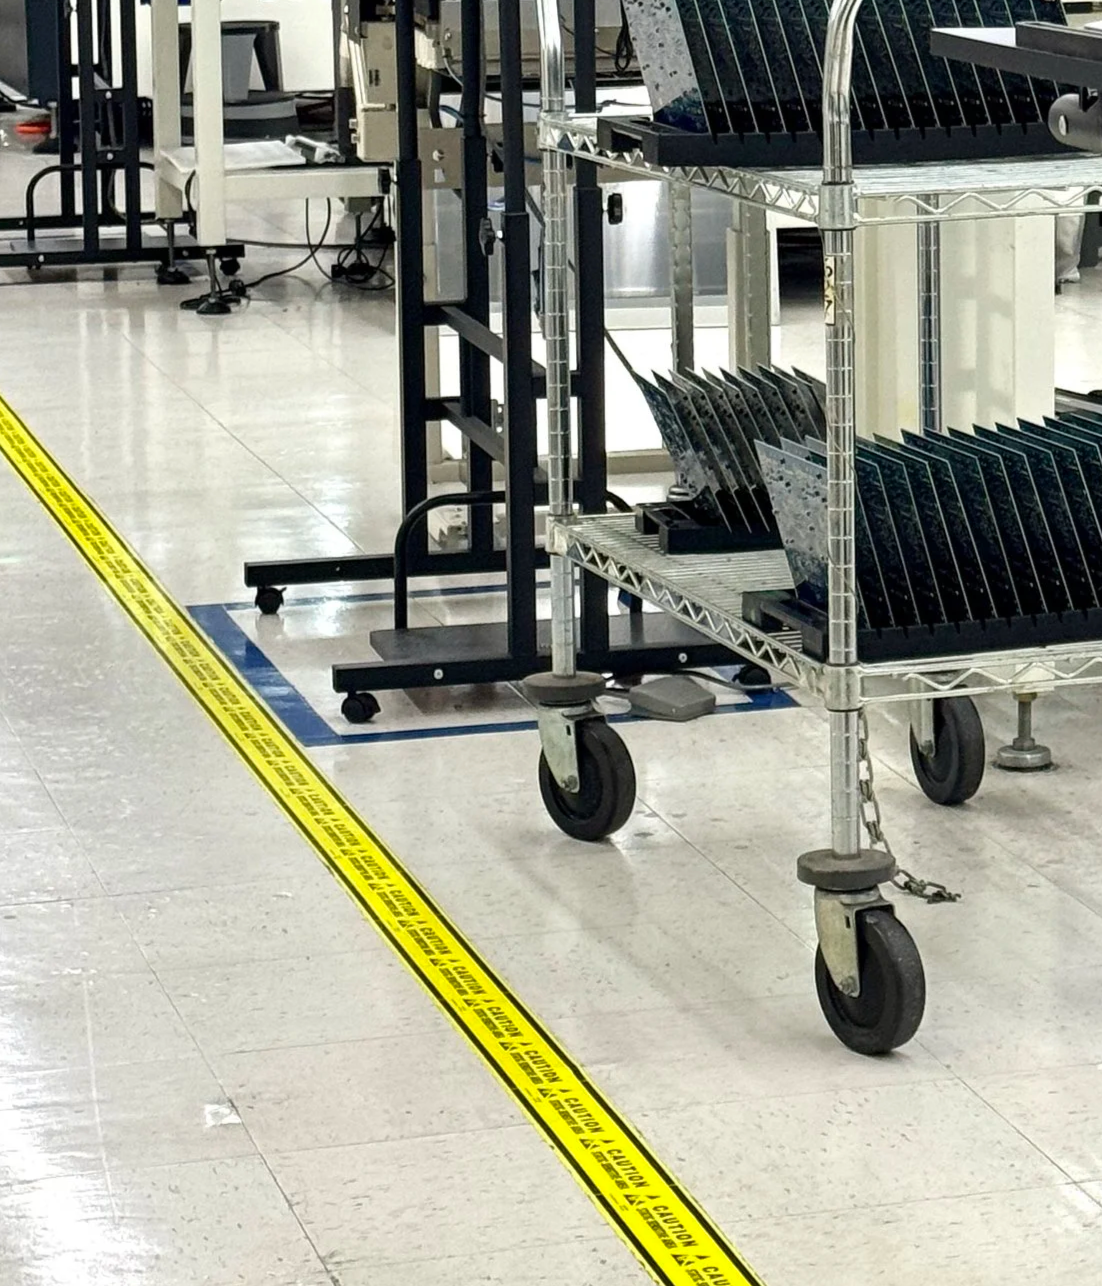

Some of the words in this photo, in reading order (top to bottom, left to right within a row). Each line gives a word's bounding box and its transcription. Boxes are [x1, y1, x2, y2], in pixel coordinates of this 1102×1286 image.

[389, 890, 420, 916] CAUTION
[420, 927, 452, 954] CAUTION
[452, 966, 487, 994] CAUTION
[486, 1006, 523, 1037] CAUTION
[524, 1050, 563, 1083] CAUTION
[564, 1097, 605, 1133] CAUTION
[606, 1148, 650, 1188] CAUTION
[652, 1205, 698, 1247] CAUTION
